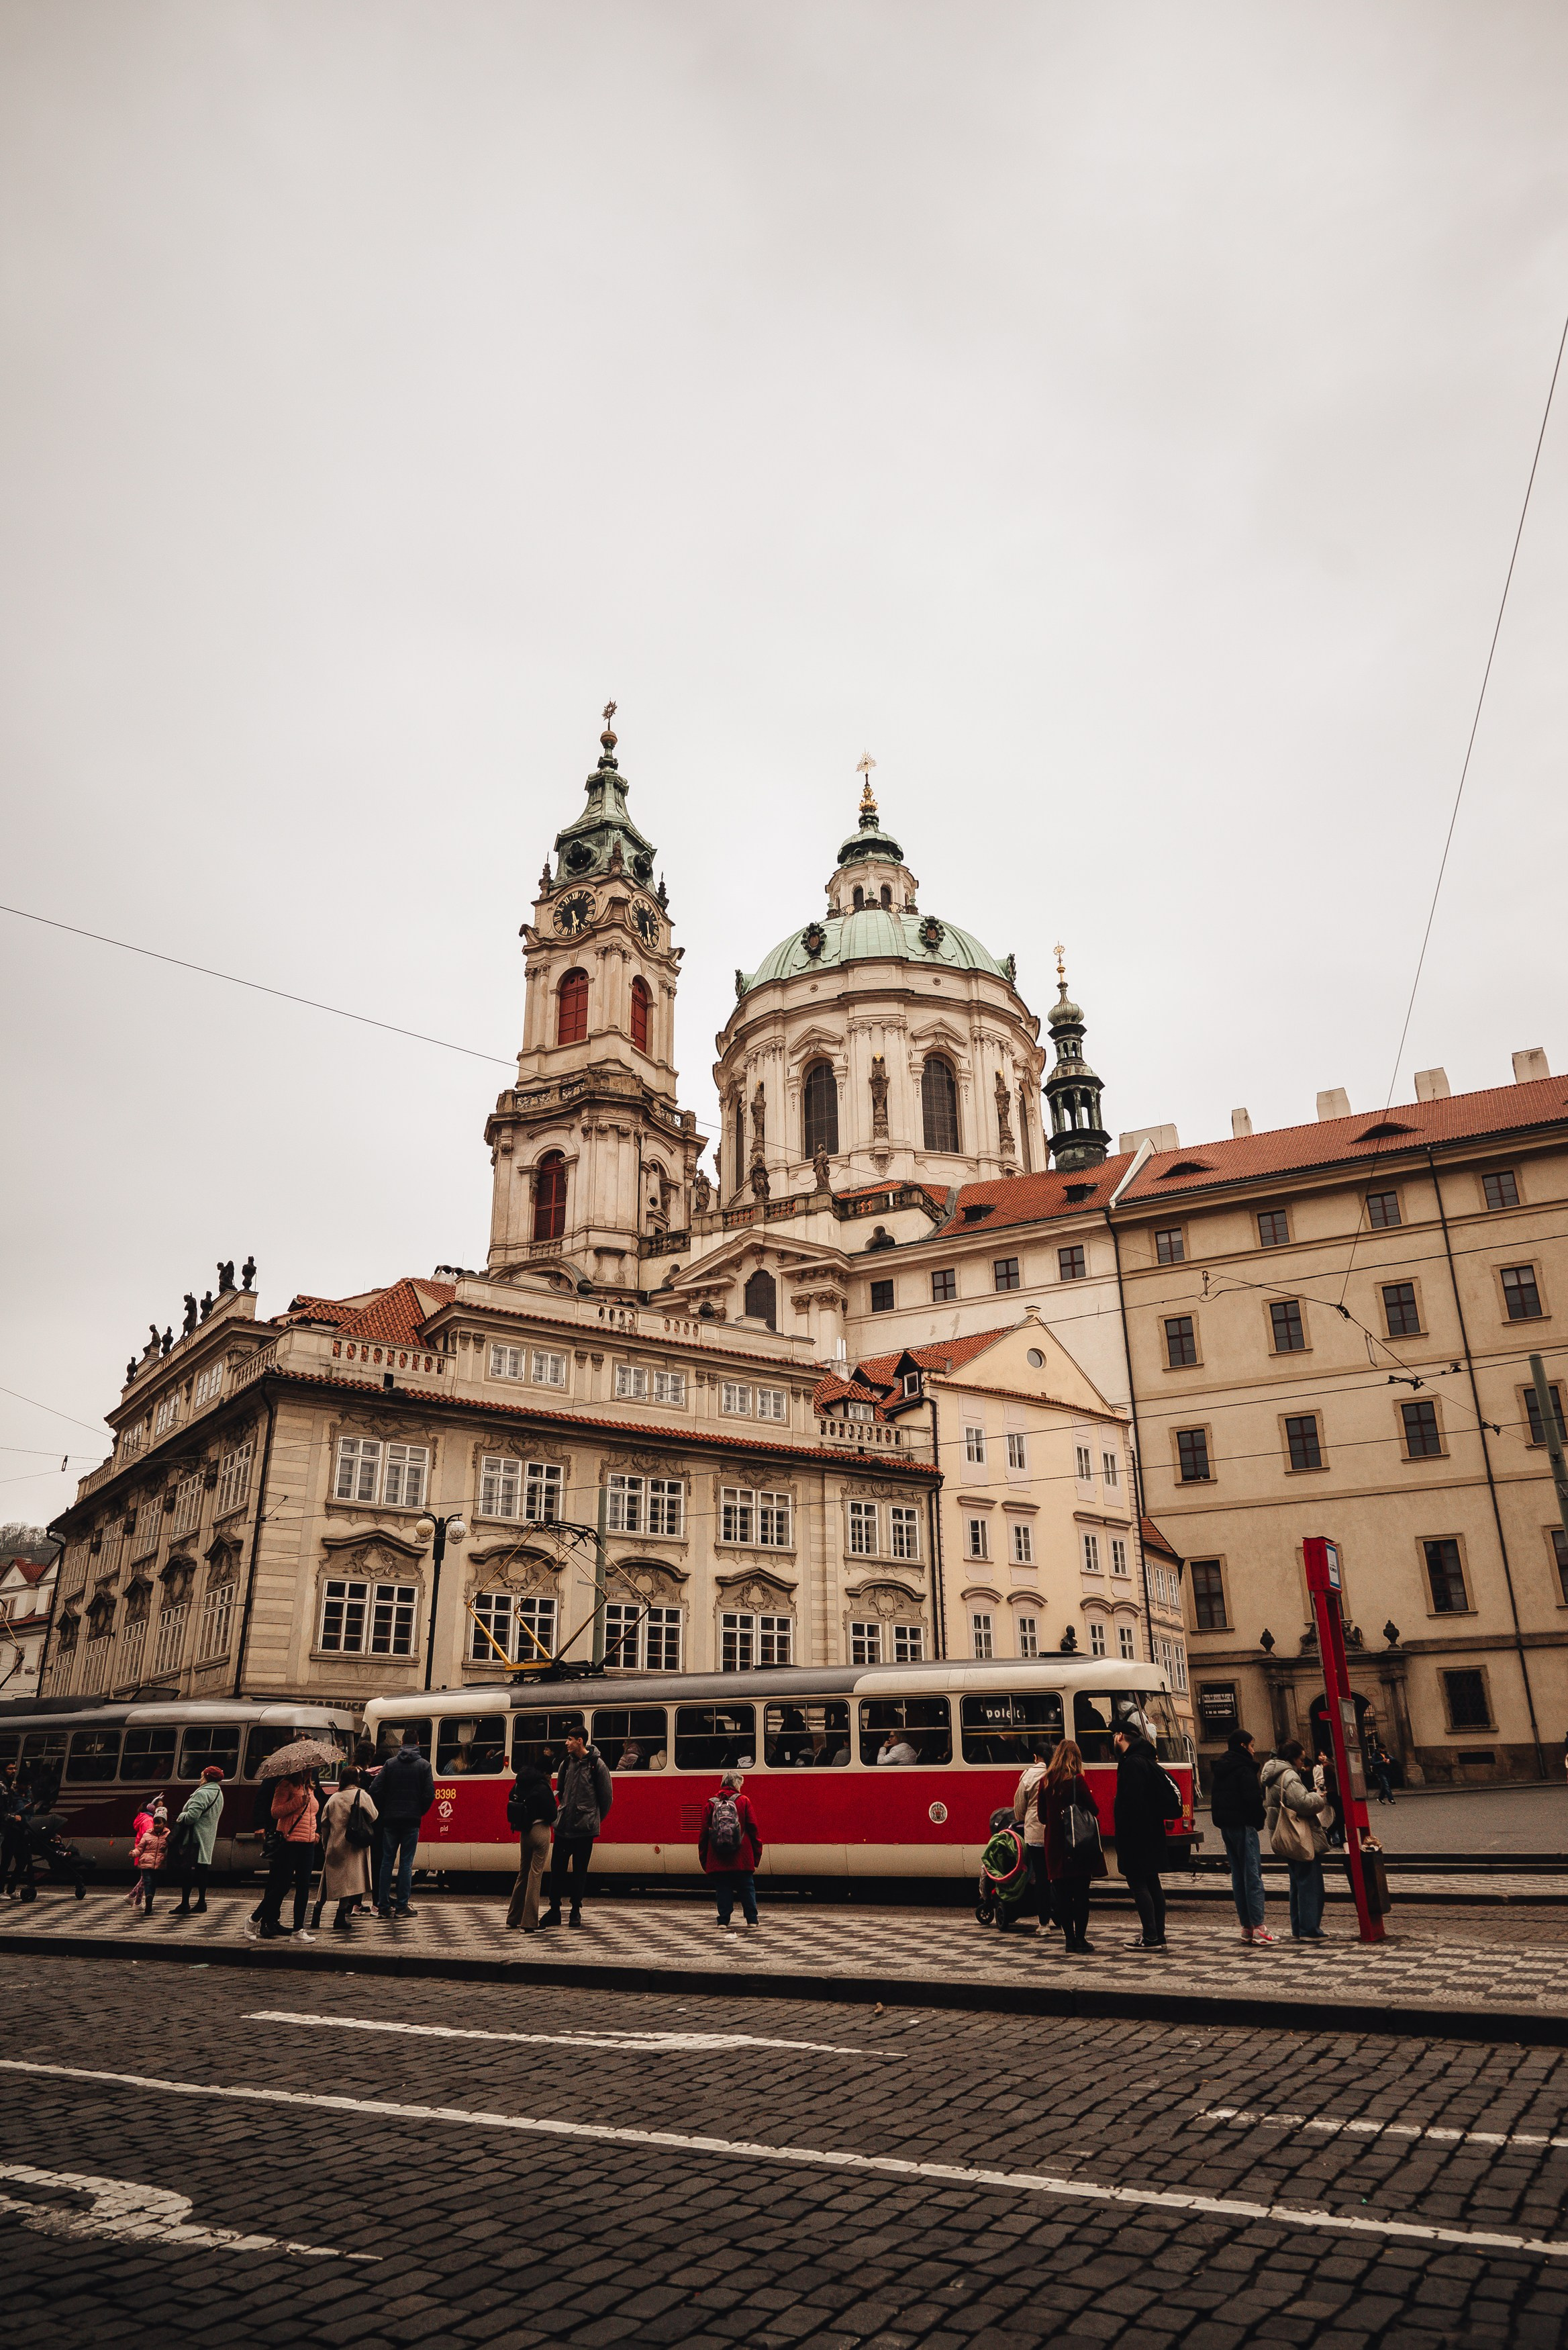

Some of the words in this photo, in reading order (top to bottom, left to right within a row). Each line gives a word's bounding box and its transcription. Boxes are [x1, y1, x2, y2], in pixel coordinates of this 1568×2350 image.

[318, 1766, 332, 1779] 22
[435, 1789, 456, 1799] 8398
[440, 1825, 448, 1833] pid
